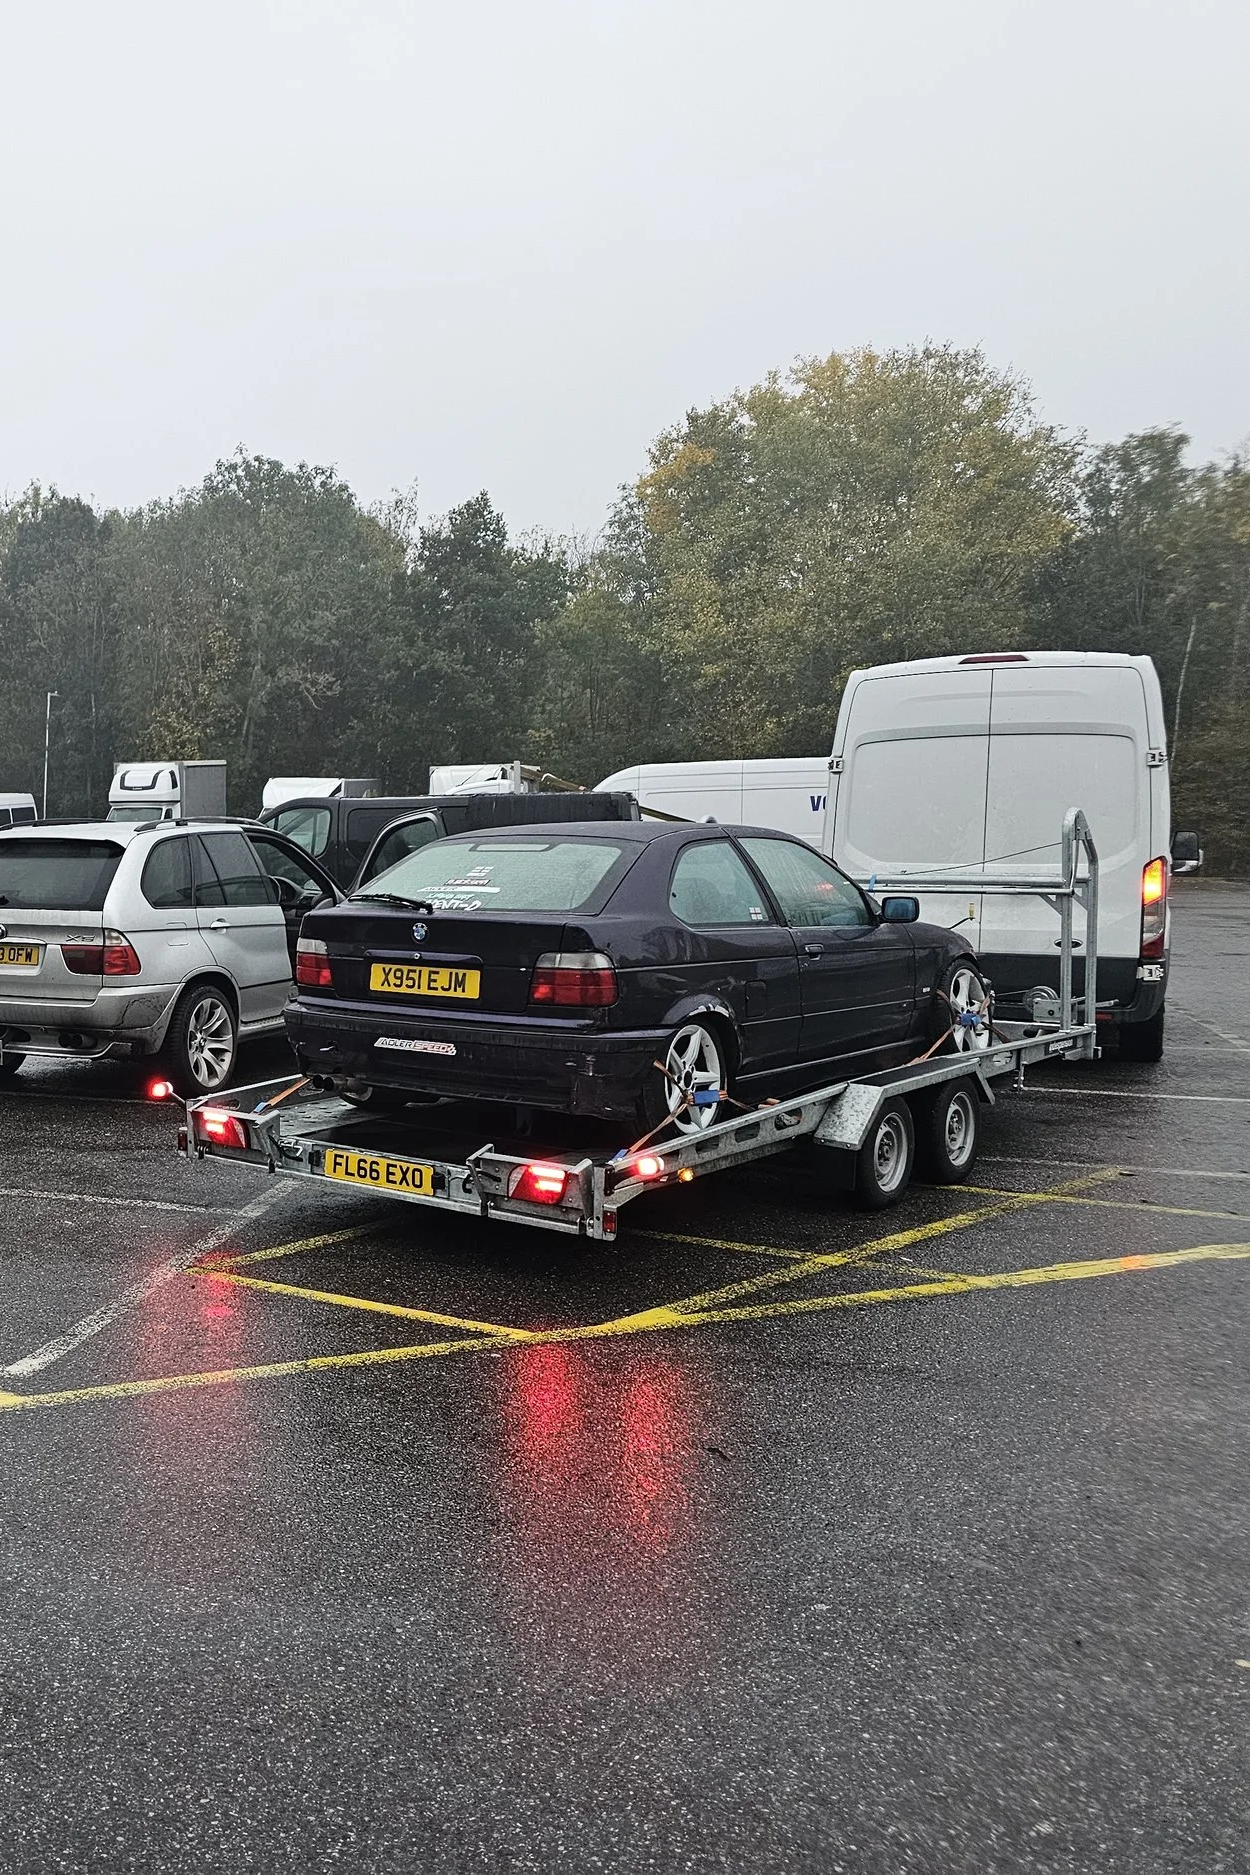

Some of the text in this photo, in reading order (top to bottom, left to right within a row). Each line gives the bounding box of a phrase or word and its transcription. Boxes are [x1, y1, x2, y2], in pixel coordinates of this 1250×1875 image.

[65, 934, 95, 942] X5
[8, 947, 33, 963] OFW
[380, 967, 467, 993] X951 EJM
[380, 1038, 412, 1048] ADLER
[333, 1153, 380, 1181] FL66
